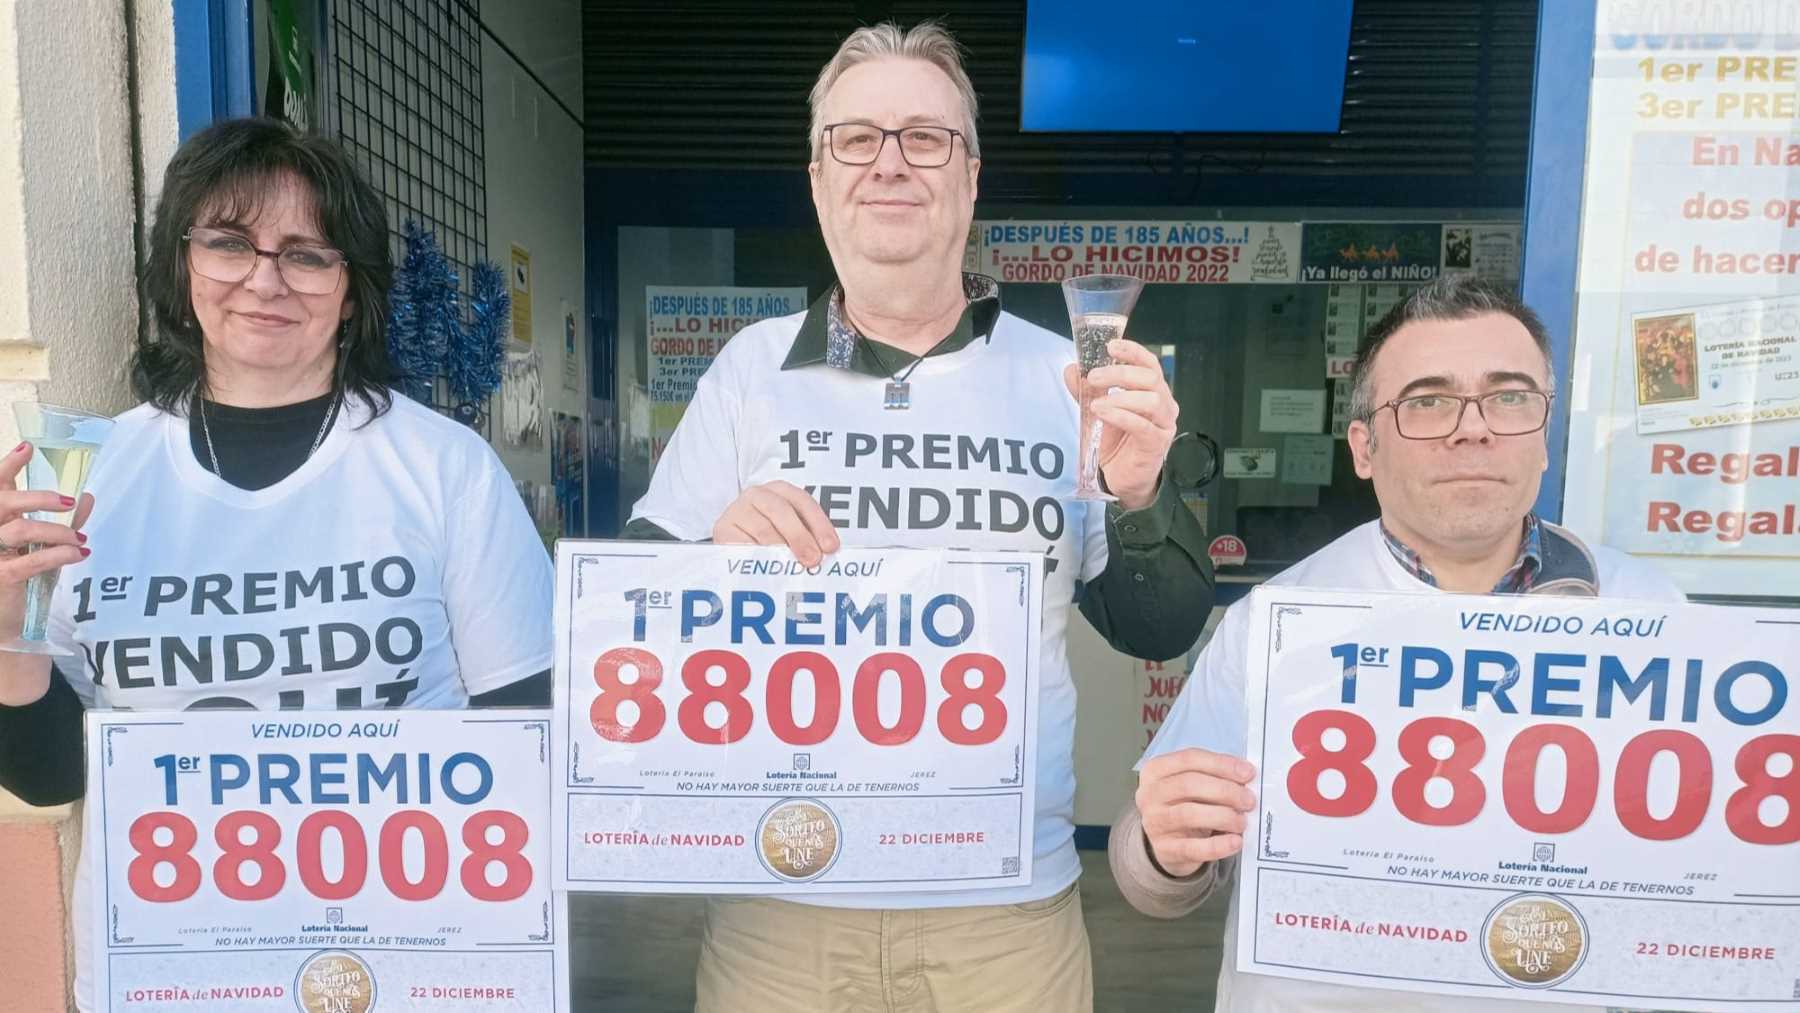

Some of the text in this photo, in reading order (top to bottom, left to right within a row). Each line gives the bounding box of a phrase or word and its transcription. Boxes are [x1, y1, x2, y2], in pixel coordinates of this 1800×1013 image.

[1638, 56, 1703, 82] 1er
[1638, 92, 1703, 119] 3er
[1692, 136, 1739, 166] En
[1683, 191, 1749, 220] dos
[985, 222, 1084, 247] ¡DESPUÉS
[1092, 226, 1117, 243] DE
[1125, 226, 1159, 243] 185
[1086, 246, 1240, 263] HICIMOS!
[1635, 244, 1800, 274] de hacer
[1003, 263, 1229, 282] GORDO DE NAVIDAD 2022
[1331, 264, 1370, 283] llegó
[1372, 265, 1387, 280] el
[1391, 263, 1437, 280] NIÑO!
[714, 297, 729, 316] DE
[733, 297, 753, 316] 185
[651, 337, 694, 356] GORDO
[698, 337, 714, 356] DE
[780, 429, 1064, 480] 1er PREMIO
[1651, 443, 1800, 484] Regal
[803, 485, 1064, 541] ENDIDO
[1647, 501, 1800, 542] Regal
[727, 558, 884, 577] VENDIDO AQUÍ
[73, 556, 416, 623] 1er PREMIO
[624, 588, 975, 647] 1er PREMIO
[1459, 612, 1667, 638] VENDIDO AQUÍ
[590, 647, 1008, 746] 88008
[1331, 642, 1788, 726] 1er PREMIO
[251, 719, 400, 738] VENDIDO AQUÍ
[154, 752, 494, 805] 1er PREMIO
[676, 782, 919, 792] NO HAY MAYOR SUERTE QUE LA DE TENERNOS
[800, 770, 837, 779] Nacional
[1287, 709, 1800, 845] 88008
[584, 831, 745, 847] LOTERÍA de NAVIDAD
[879, 832, 984, 845] 22 DICIEMBRE
[127, 810, 533, 903] 88008
[1540, 864, 1588, 875] Nacional
[1387, 865, 1695, 896] NO HAY MAYOR SUERTE QUE LA DE TENERNOS
[1683, 872, 1718, 881] JEREZ
[1275, 912, 1468, 943] LOTERÍA de NAVIDAD
[215, 936, 446, 946] NO HAY MAYOR SUERTE QUE LA DE TENERNOS
[1636, 942, 1776, 960] 22 DICIEMBRE
[126, 986, 284, 1001] LOTERÍA de NAVIDAD
[411, 987, 514, 999] 22 DICIEMBRE
